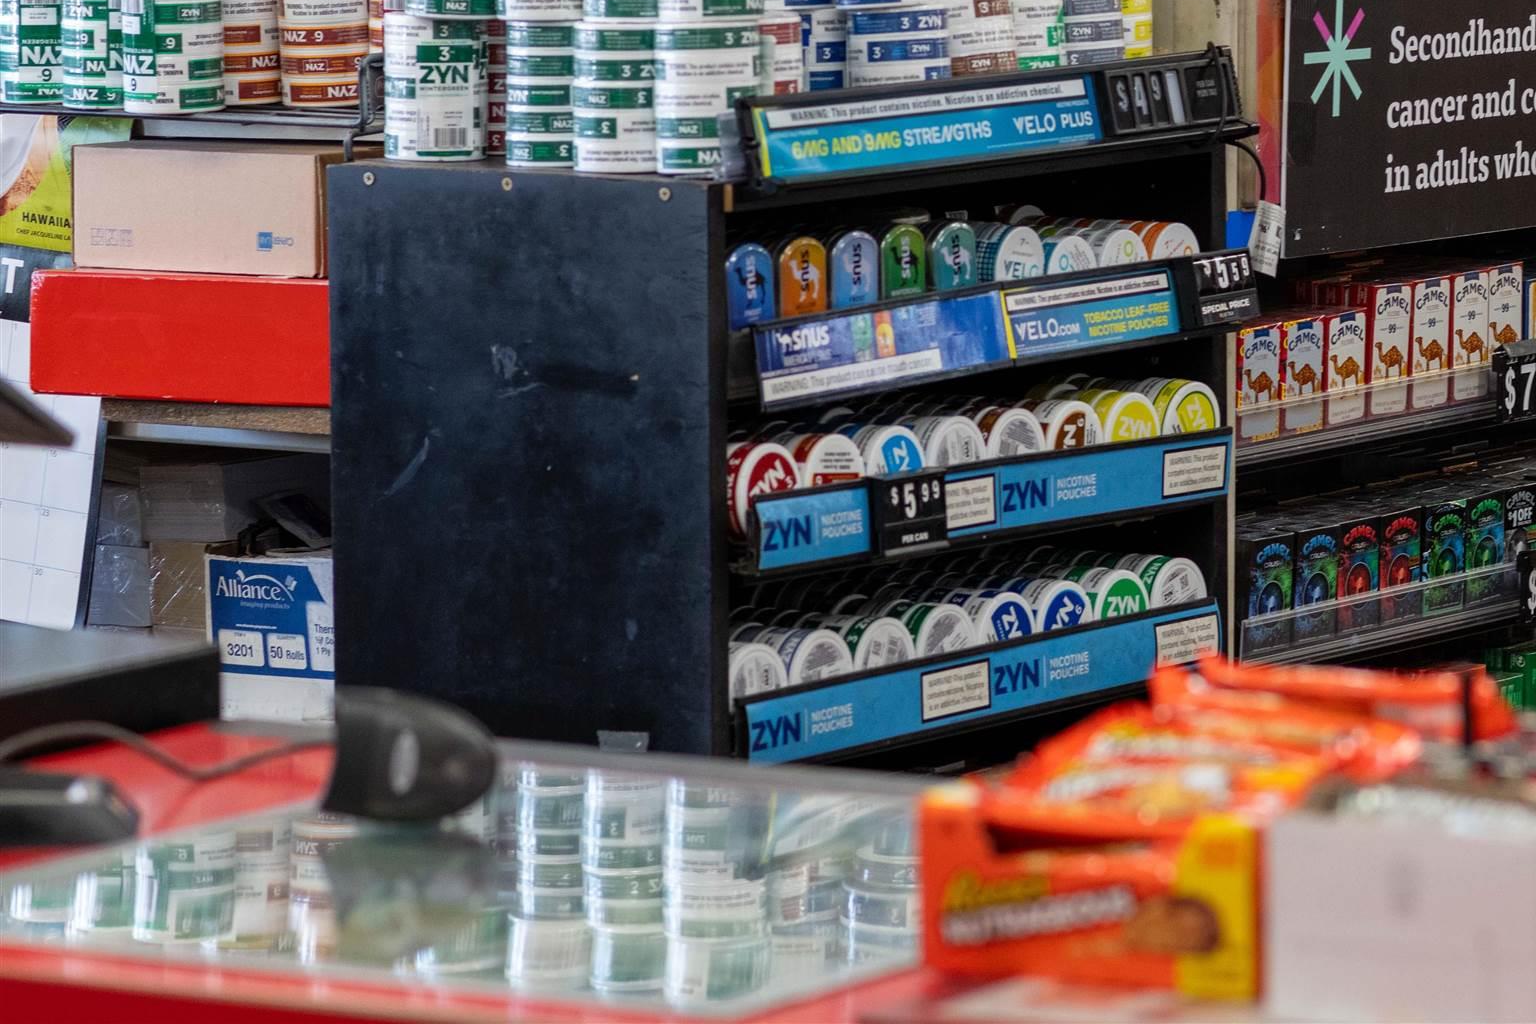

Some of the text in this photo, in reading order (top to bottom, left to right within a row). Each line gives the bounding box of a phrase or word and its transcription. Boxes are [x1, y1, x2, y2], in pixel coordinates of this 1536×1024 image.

[1390, 15, 1536, 64] Secondhand
[419, 65, 469, 84] ZYN
[1387, 95, 1468, 129] cancer
[1472, 79, 1516, 120] and
[1013, 110, 1093, 136] VELO PLUS
[791, 121, 992, 160] 6MG AND 9MG STRENGTHS
[1385, 154, 1410, 192] in
[1416, 147, 1489, 190] adults
[1083, 301, 1170, 325] TOBACCO LEAF-FREE
[1377, 296, 1410, 315] CAMEL
[1089, 315, 1169, 338] NICOTINE POUCHES
[1056, 473, 1098, 490] NICOTINE
[1056, 485, 1098, 501] POUCHES
[1002, 477, 1049, 513] ZYN
[227, 643, 254, 658] 3201
[270, 646, 305, 661] 50 Rolls
